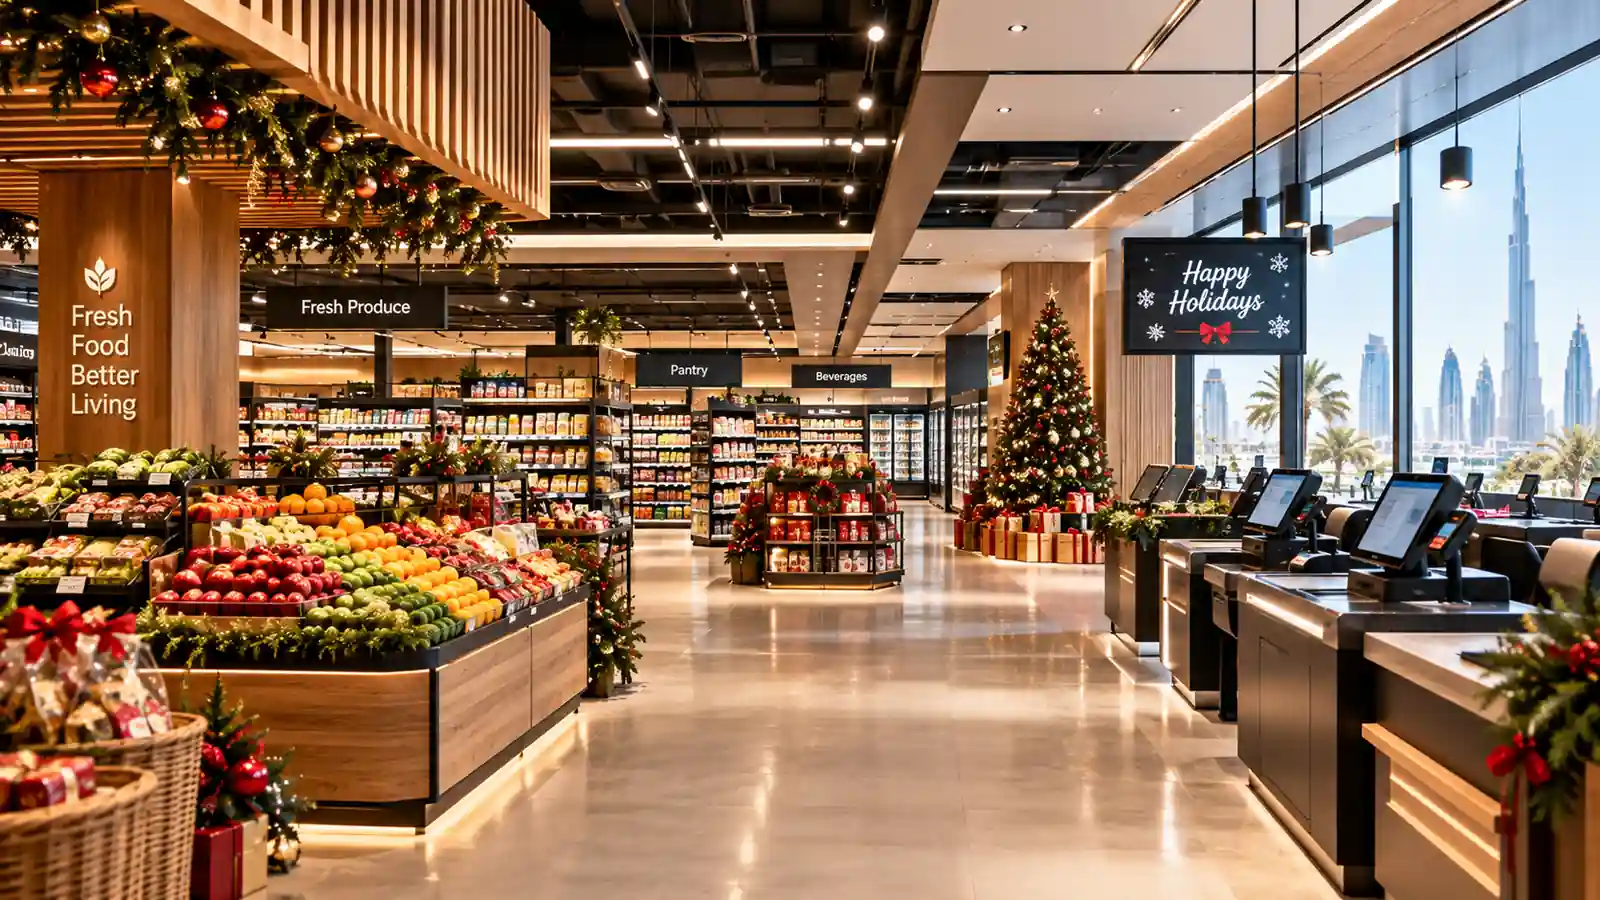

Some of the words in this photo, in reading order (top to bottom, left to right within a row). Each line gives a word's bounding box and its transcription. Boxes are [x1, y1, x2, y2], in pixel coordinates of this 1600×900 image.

[1182, 259, 1252, 290] Happy
[72, 304, 132, 326] Fresh
[301, 299, 343, 315] Fresh
[347, 299, 411, 315] Produce
[1168, 288, 1265, 320] Holidays
[72, 333, 129, 356] Food
[71, 364, 140, 386] Better
[670, 364, 709, 378] Pantry
[815, 371, 868, 384] Beverages
[71, 392, 137, 421] Living
